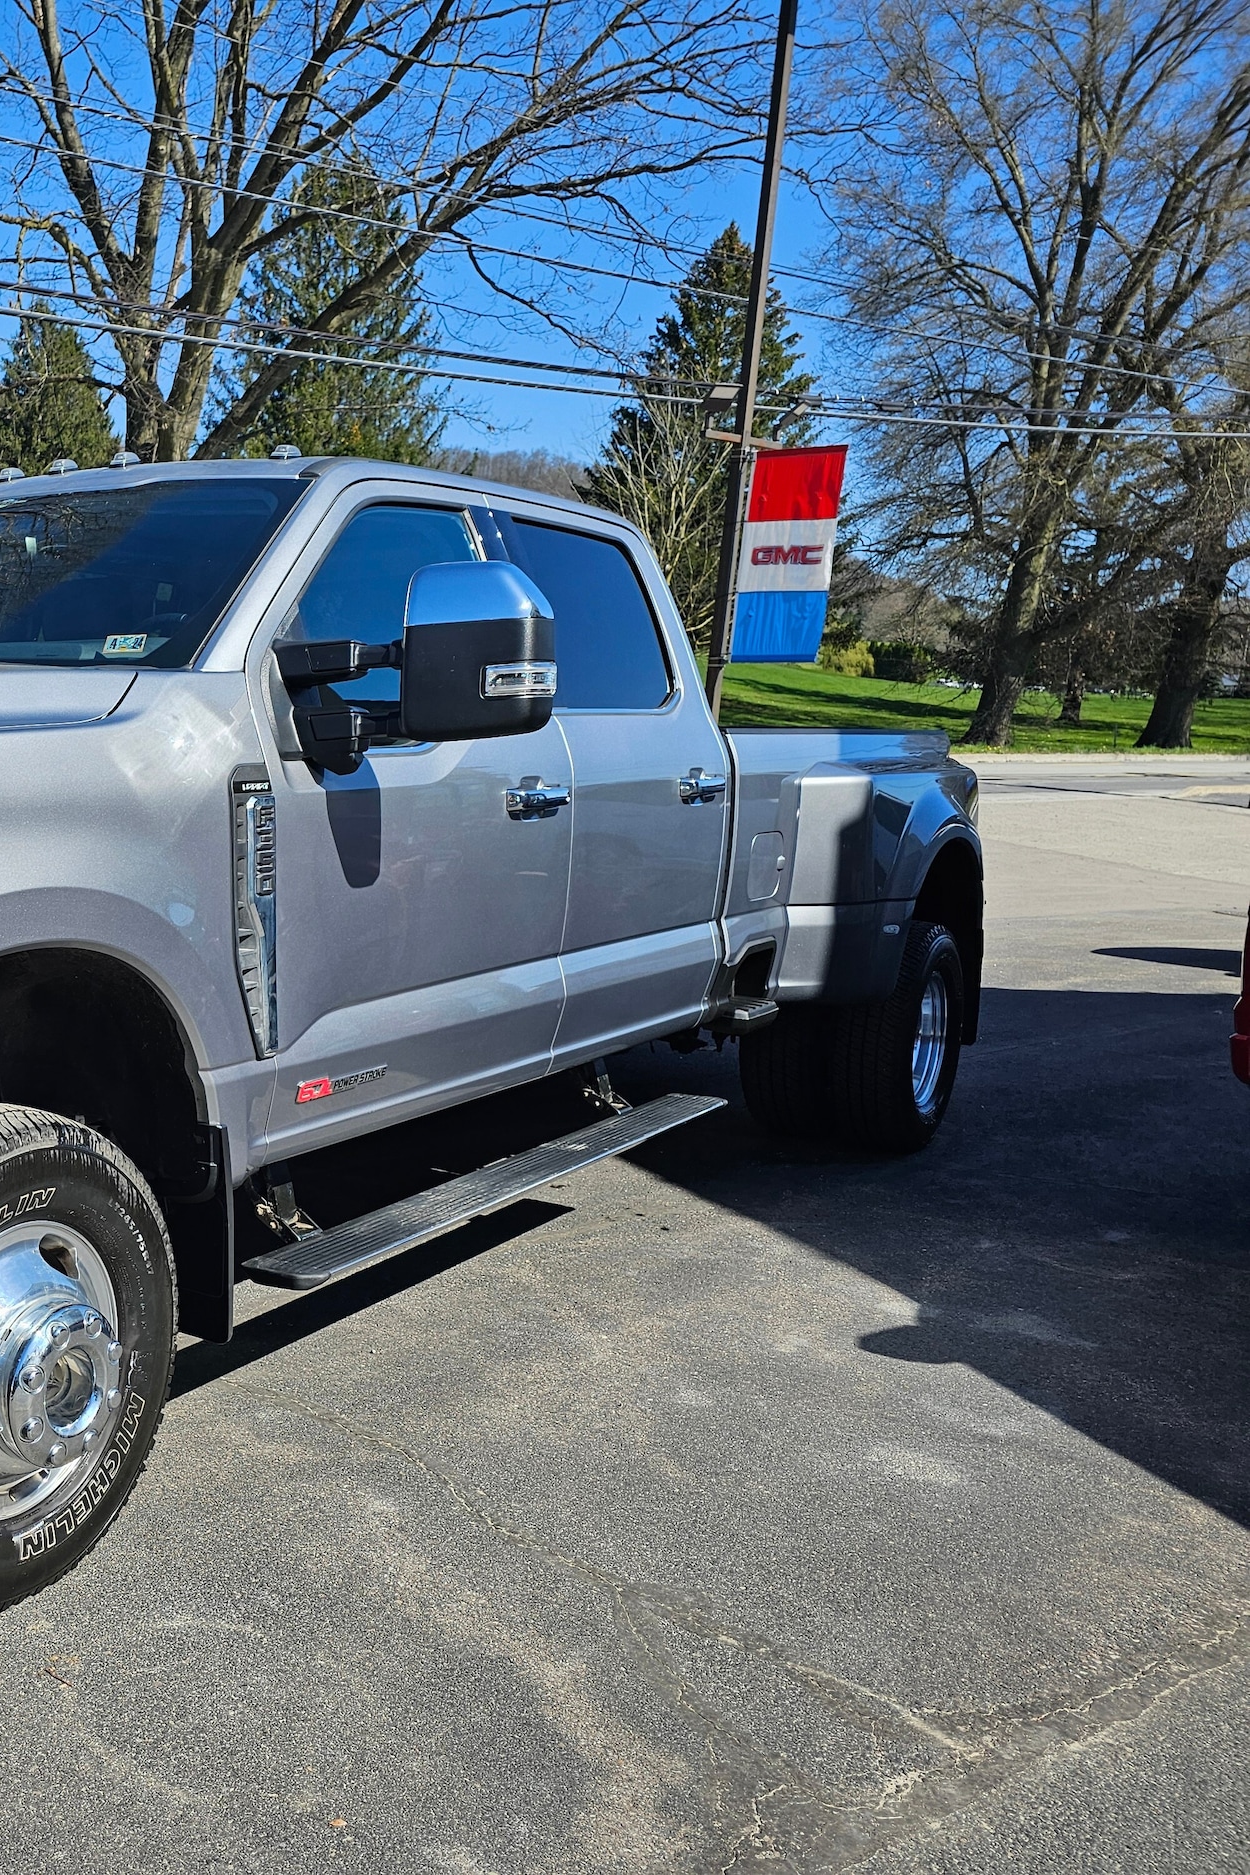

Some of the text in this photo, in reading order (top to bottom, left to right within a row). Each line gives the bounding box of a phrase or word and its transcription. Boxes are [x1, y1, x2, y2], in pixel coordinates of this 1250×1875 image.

[751, 544, 825, 566] GMC
[333, 1075, 358, 1090] POWER
[358, 1067, 388, 1084] STROKE
[20, 1392, 146, 1561] MICHELIN
